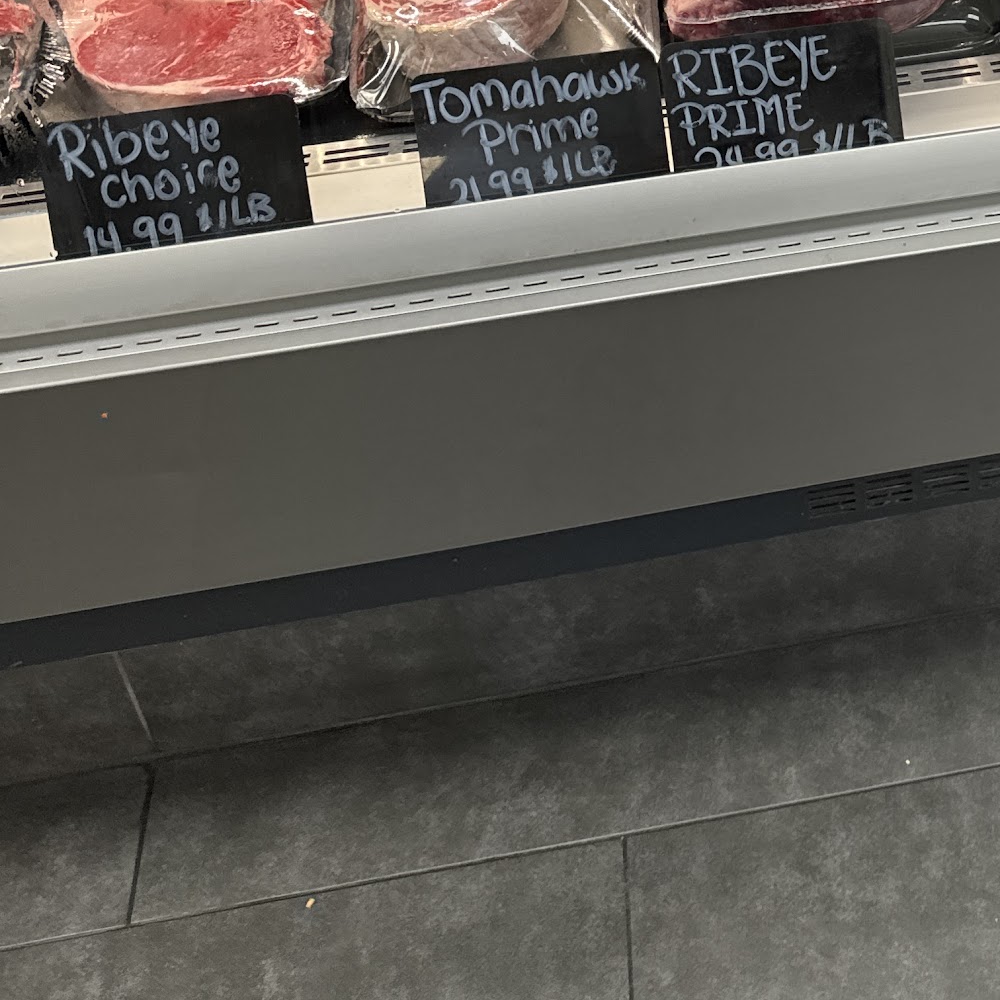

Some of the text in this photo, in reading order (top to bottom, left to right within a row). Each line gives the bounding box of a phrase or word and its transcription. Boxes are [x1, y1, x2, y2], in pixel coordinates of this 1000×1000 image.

[410, 60, 646, 125] Tomahawk
[666, 34, 837, 99] RIBEYE
[461, 107, 600, 166] Prime
[670, 91, 815, 147] PRIME
